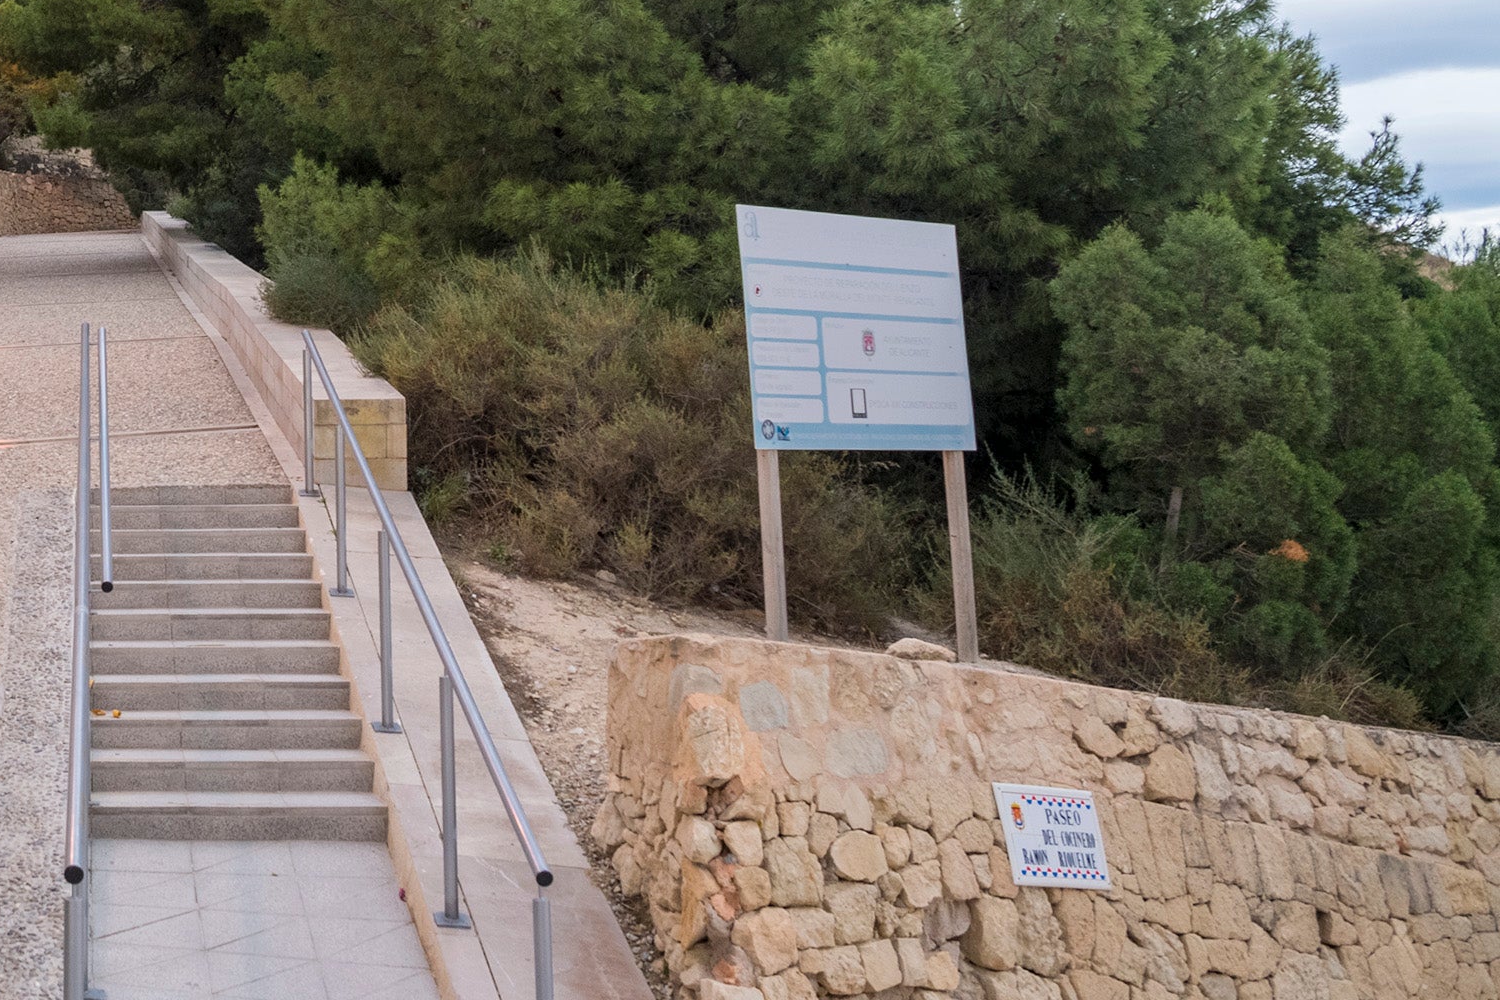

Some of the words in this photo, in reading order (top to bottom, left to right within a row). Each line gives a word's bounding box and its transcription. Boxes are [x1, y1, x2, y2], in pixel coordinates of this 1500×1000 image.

[1045, 809, 1081, 825] PASEO
[1042, 830, 1058, 846] DEL
[1061, 831, 1095, 848] COCINERO
[1058, 851, 1097, 869] RIQUELME
